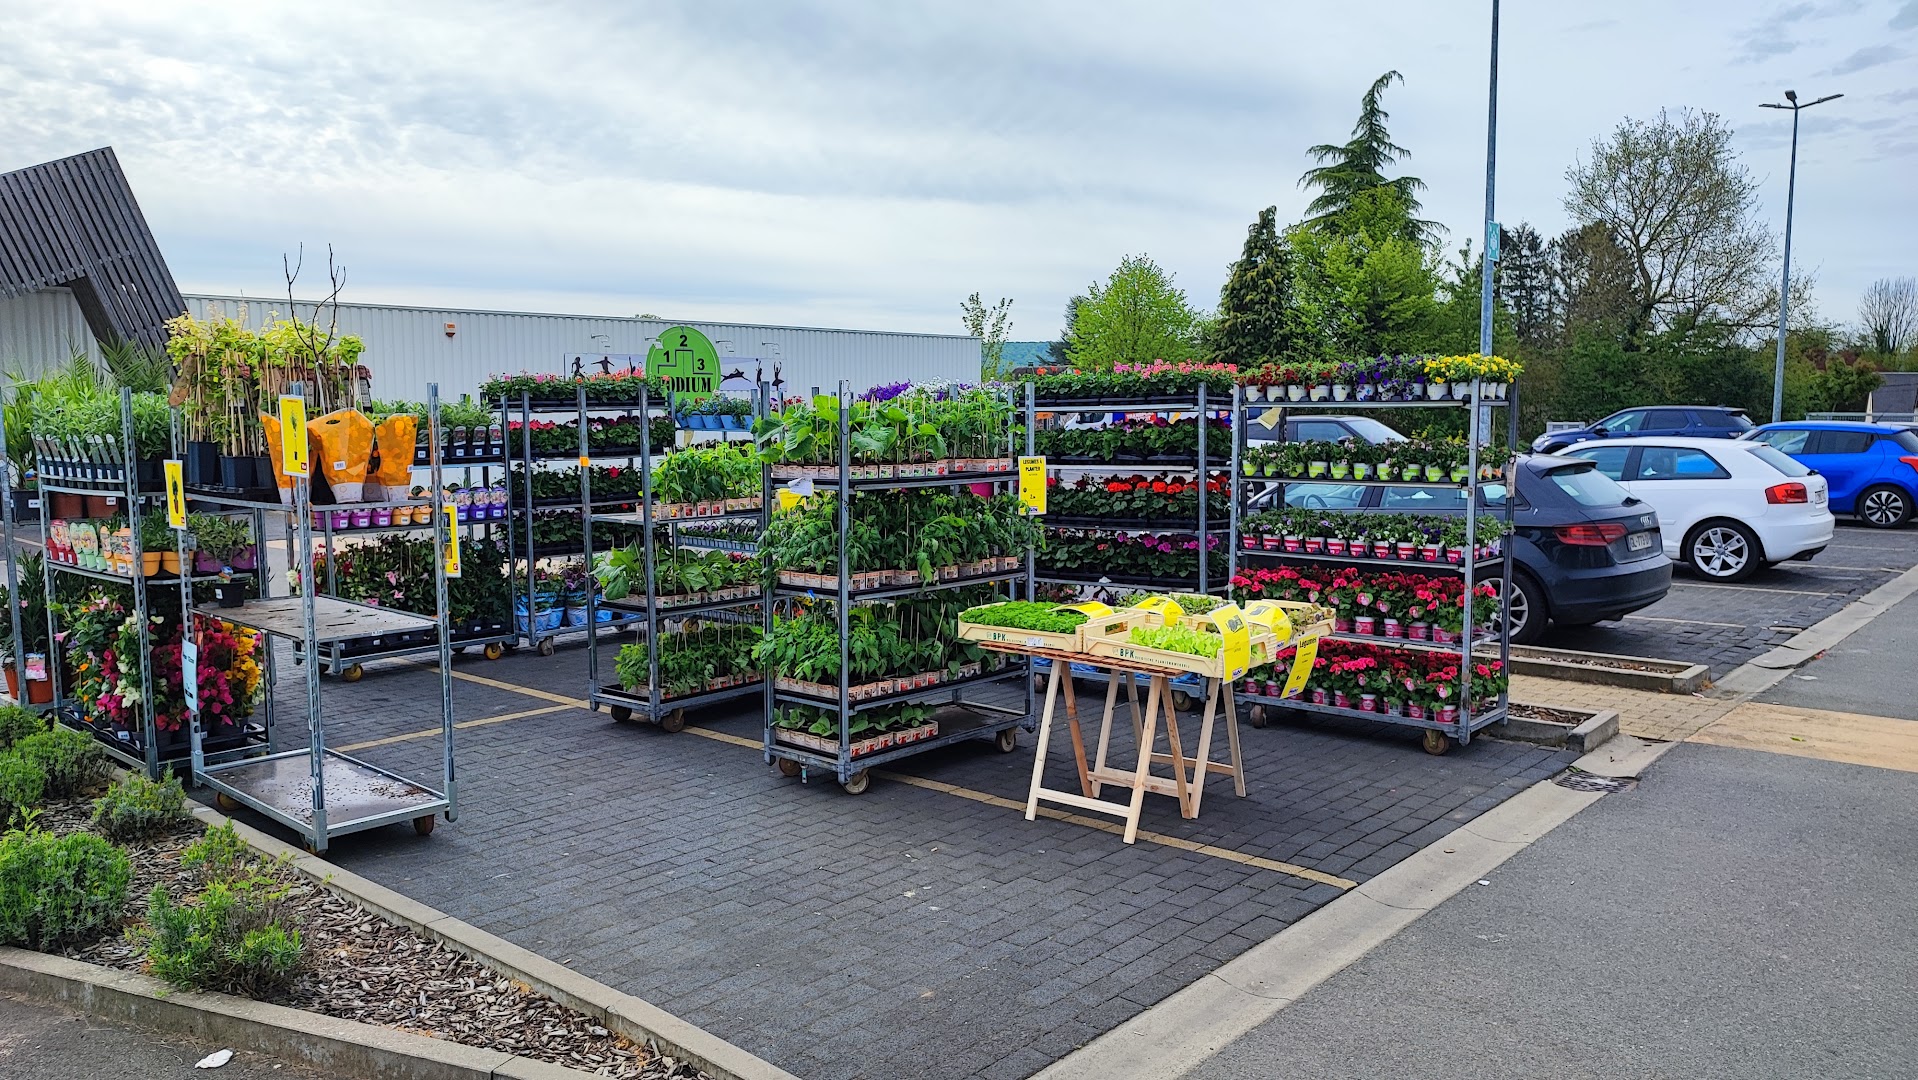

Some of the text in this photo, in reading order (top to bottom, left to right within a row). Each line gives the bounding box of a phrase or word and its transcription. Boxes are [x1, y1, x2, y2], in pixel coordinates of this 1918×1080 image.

[679, 334, 688, 347] 2
[663, 350, 670, 363] 1
[697, 358, 705, 371] 3
[992, 632, 1006, 642] BPK
[1119, 648, 1135, 658] BPK
